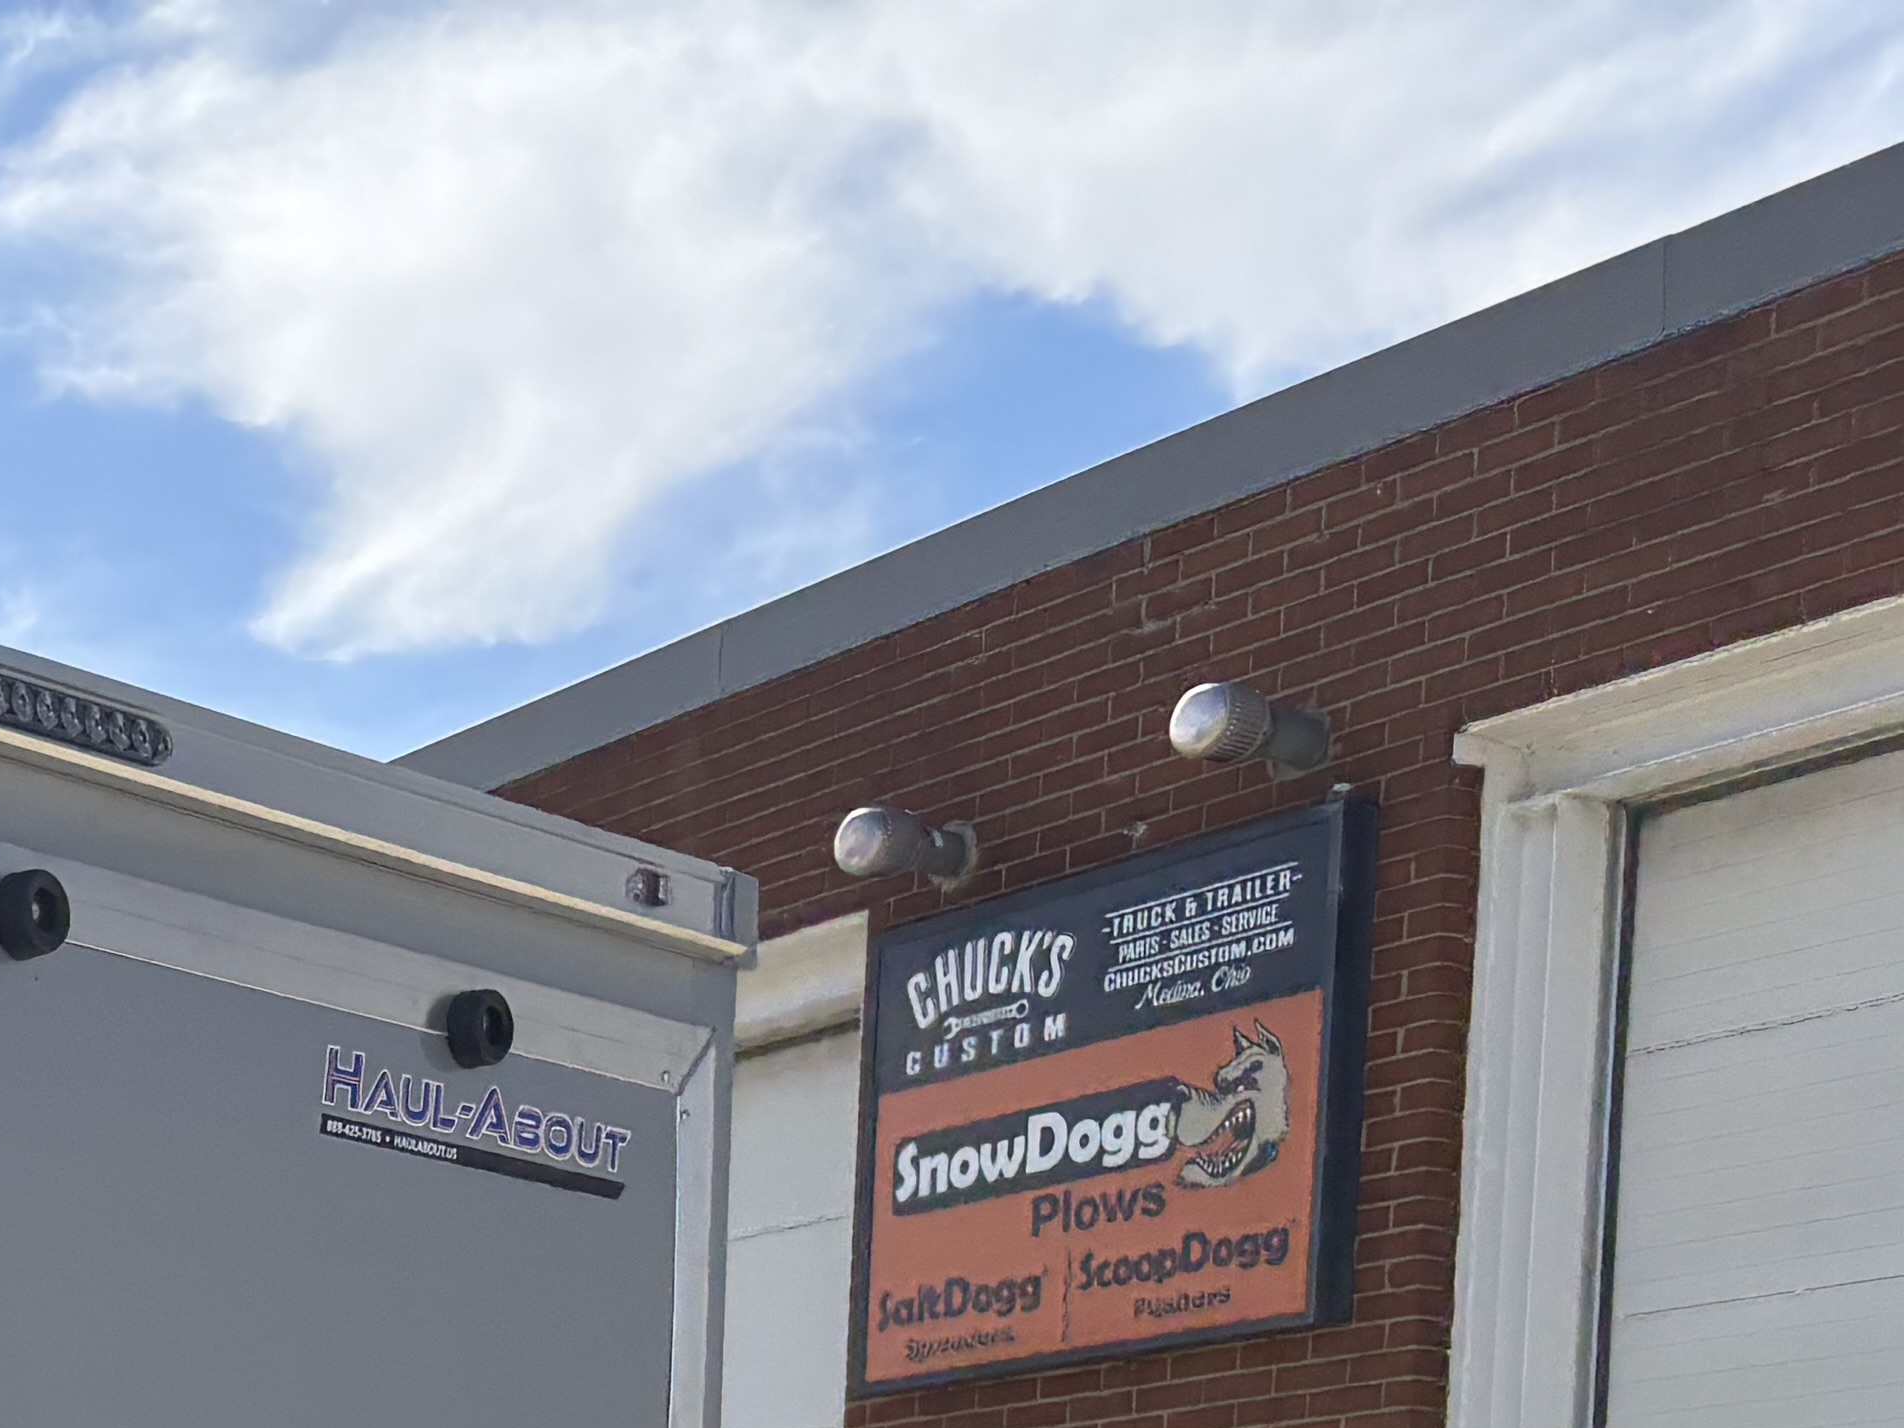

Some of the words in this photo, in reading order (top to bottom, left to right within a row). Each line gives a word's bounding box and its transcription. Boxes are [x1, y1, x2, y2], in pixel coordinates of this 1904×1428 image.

[1118, 936, 1159, 963] PARTS
[1170, 921, 1210, 949] SALES
[1221, 904, 1279, 936] SERVICE
[1185, 897, 1197, 918] &
[907, 930, 1077, 1029] CHUCK'S
[1104, 928, 1295, 992] CHUCKSCUSTOM.COM
[1211, 962, 1251, 992] Ohio
[906, 1013, 1067, 1075] CUSTOM
[322, 1045, 631, 1173] HAUL-ABOUT
[895, 1102, 1172, 1203] SnowDogg
[1030, 1182, 1166, 1238] Plows
[1076, 1227, 1290, 1290] ScoopDogg
[878, 1276, 1042, 1333] SaltDogg
